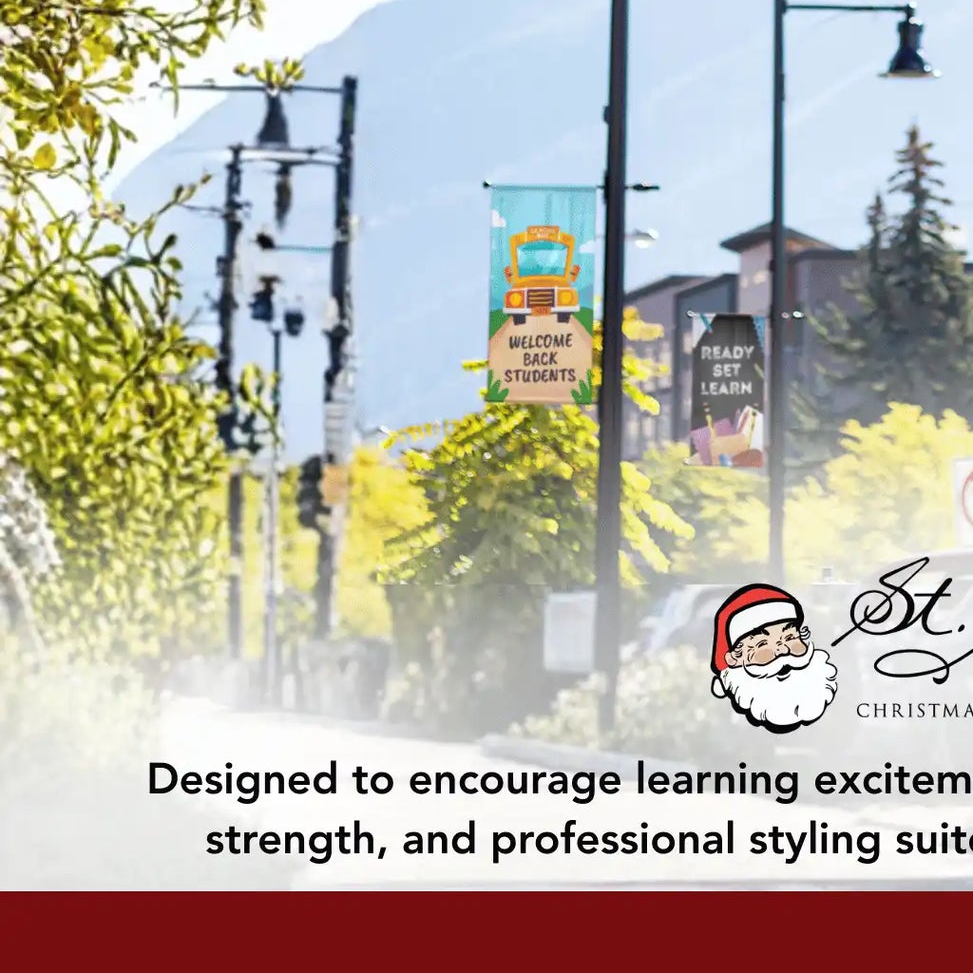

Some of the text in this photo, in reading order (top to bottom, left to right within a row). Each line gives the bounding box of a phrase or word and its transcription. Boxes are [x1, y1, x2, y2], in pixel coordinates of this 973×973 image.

[509, 333, 573, 349] WELCOME
[523, 351, 558, 367] BACK
[701, 345, 755, 360] READY
[504, 368, 576, 384] STUDENTS
[712, 363, 742, 378] SET
[701, 381, 753, 396] LEARN
